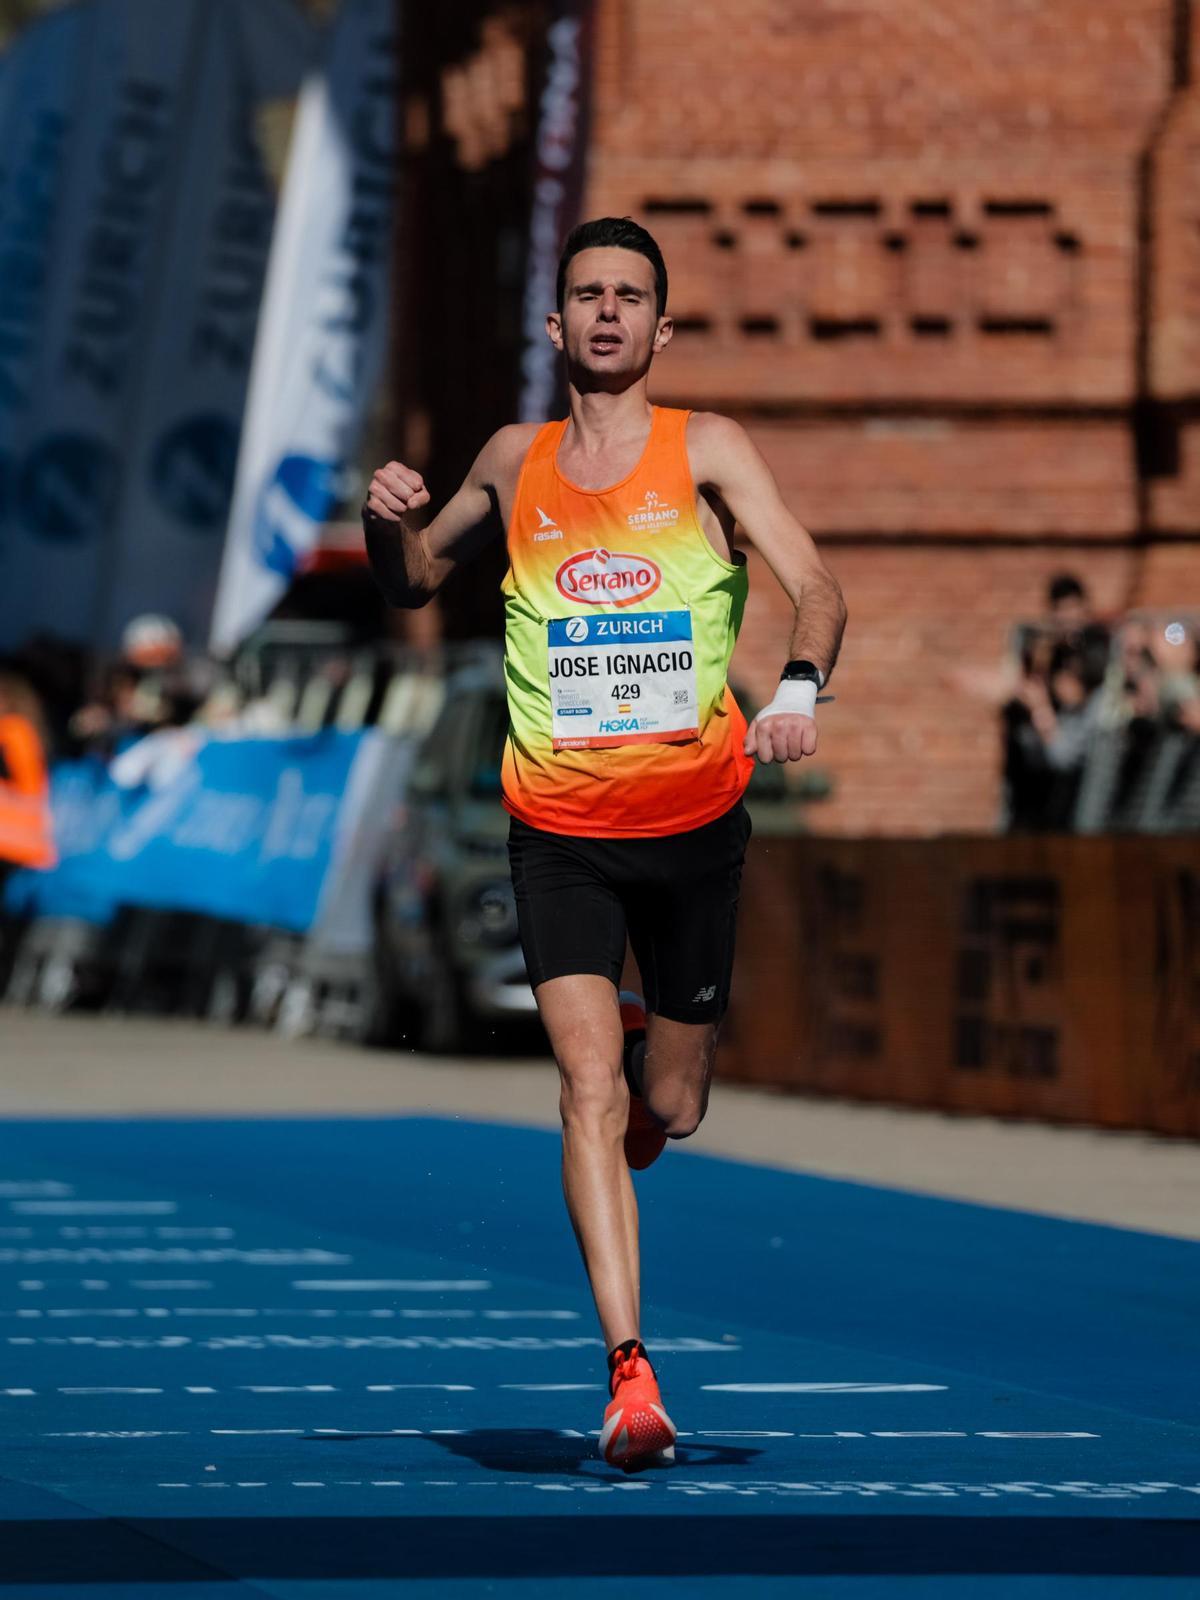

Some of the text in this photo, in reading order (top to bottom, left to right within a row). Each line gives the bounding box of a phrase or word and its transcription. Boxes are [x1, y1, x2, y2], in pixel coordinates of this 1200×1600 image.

[627, 509, 679, 525] SERRANO
[567, 568, 651, 592] Serrano
[596, 619, 663, 635] ZURICH
[549, 651, 693, 678] JOSE IGNACIO
[611, 684, 641, 700] 429
[599, 718, 639, 733] HOKA
